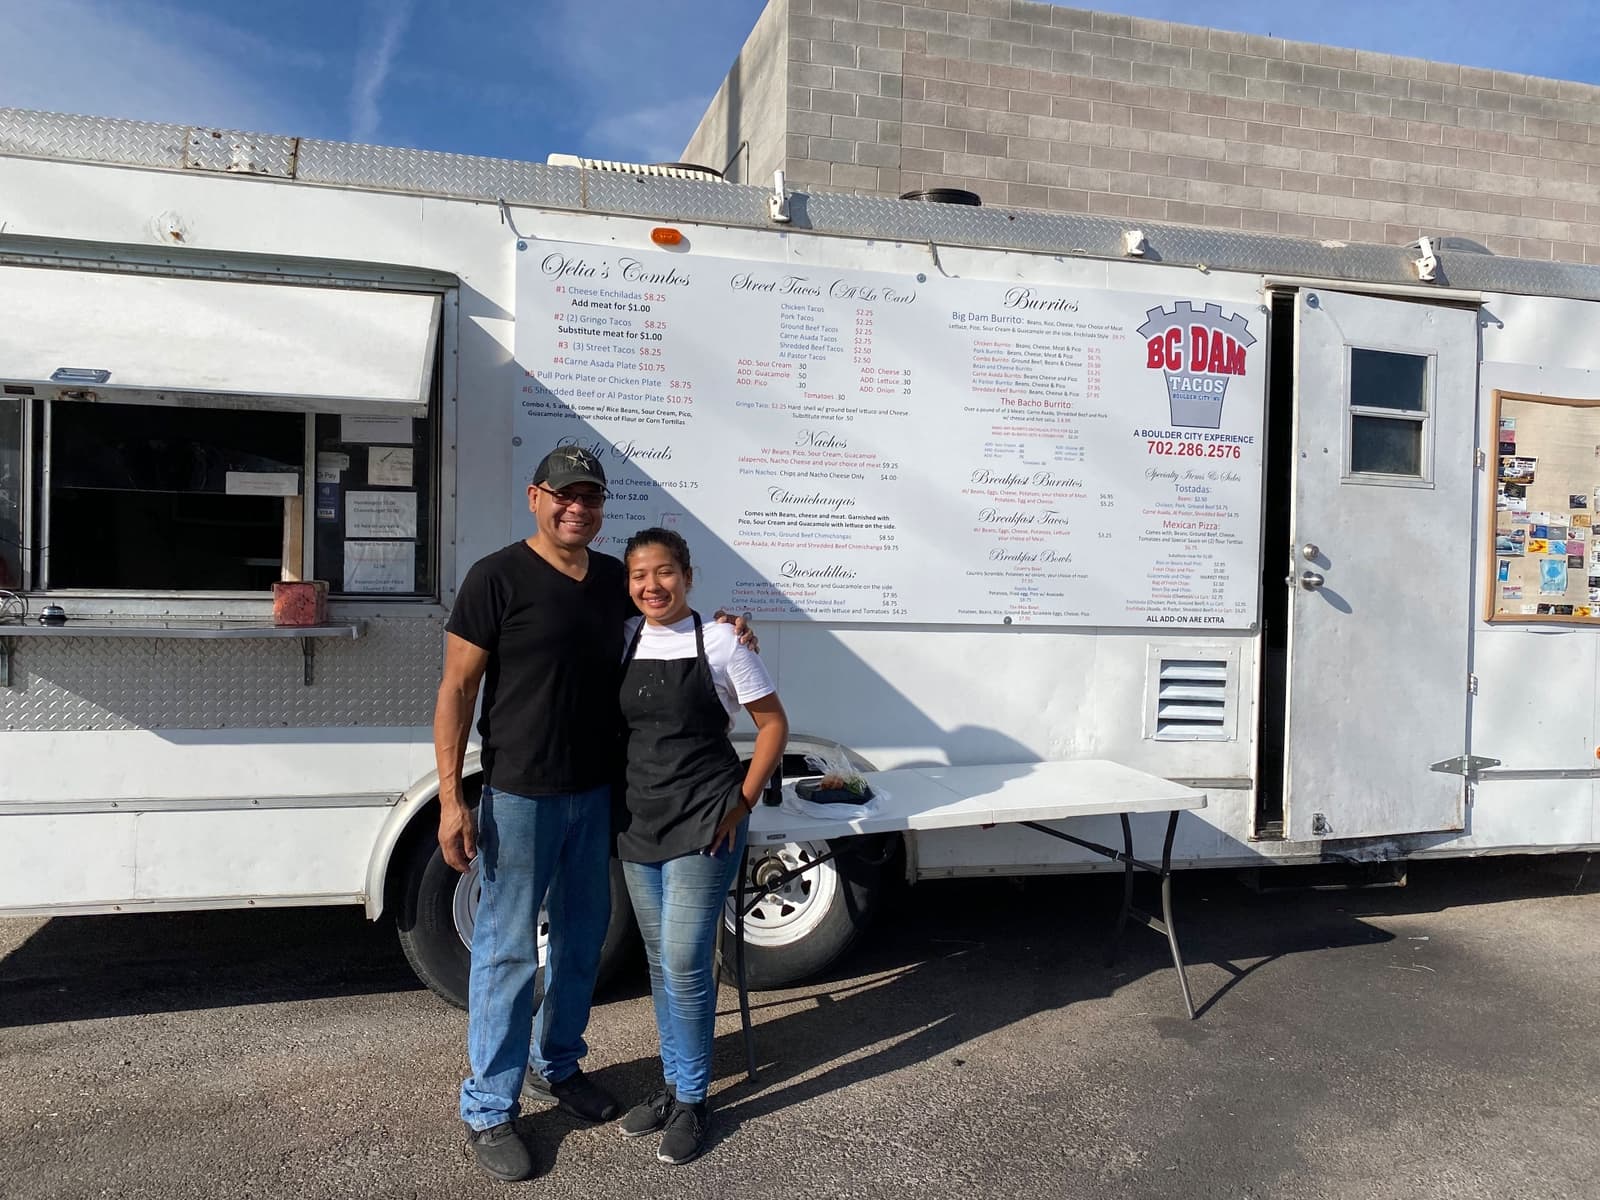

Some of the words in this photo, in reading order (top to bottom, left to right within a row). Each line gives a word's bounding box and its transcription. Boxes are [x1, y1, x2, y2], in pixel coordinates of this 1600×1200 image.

[541, 253, 610, 281] Ofelia's
[618, 258, 691, 287] Combos
[556, 285, 566, 294] #1
[568, 286, 598, 296] Cheese
[600, 289, 642, 299] Enchiladas
[644, 291, 666, 301] $8.25
[730, 274, 775, 293] Street
[779, 276, 820, 296] Tacos
[571, 299, 589, 308] Add
[614, 302, 626, 311] for
[628, 303, 650, 312] $1.00
[1004, 287, 1079, 312] Burritos
[554, 313, 564, 321] #2
[566, 313, 578, 323] (2)
[580, 315, 606, 326] Gringo
[610, 317, 632, 326] Tacos
[644, 319, 667, 329] $8.25
[952, 312, 966, 322] Big
[968, 313, 988, 322] Dam
[991, 315, 1025, 324] Burrito:
[558, 326, 600, 336] Substitute
[603, 330, 624, 338] meat
[626, 331, 638, 339] for
[640, 331, 662, 341] $1.00
[558, 342, 568, 350] #3
[572, 342, 584, 352] (3)
[586, 343, 610, 353] Street
[613, 345, 635, 354] Tacos
[639, 346, 662, 356] $8.25
[779, 342, 809, 350] Shredded
[1147, 328, 1181, 371] BC
[1191, 326, 1246, 376] DAM
[590, 359, 614, 368] Asada
[616, 361, 636, 370] Plate
[638, 362, 665, 372] $10.75
[537, 372, 553, 380] Pull
[554, 372, 573, 381] Pork
[575, 374, 595, 382] Plate
[608, 376, 639, 385] Chicken
[642, 378, 662, 386] Plate
[670, 379, 692, 388] $8.75
[1170, 376, 1224, 392] TACOS
[535, 387, 574, 396] Shredded
[576, 389, 596, 398] Beef
[618, 392, 643, 400] Pastor
[644, 393, 665, 402] Plate
[666, 394, 693, 403] $10.75
[1018, 399, 1042, 407] Bacho
[795, 430, 847, 448] Nachos
[1142, 430, 1182, 439] BOULDER
[1204, 434, 1254, 443] EXPERIENCE
[611, 438, 672, 464] Specials
[1147, 441, 1241, 458] 702.286.2576
[971, 468, 1029, 488] Breakfast
[1032, 471, 1082, 488] Burritos
[1145, 467, 1179, 483] Specialty
[679, 480, 699, 489] $1.75
[1174, 484, 1212, 494] Tostadas:
[628, 493, 649, 501] $2.00
[768, 486, 856, 511] Chimichangas
[978, 508, 1035, 527] Breakfast
[1037, 511, 1069, 525] Tacos
[1163, 520, 1196, 530] Mexican
[1199, 522, 1220, 530] Pizza:
[989, 549, 1037, 565] Breakfast
[1040, 550, 1072, 563] Bowls
[779, 560, 856, 579] Quesadillas:
